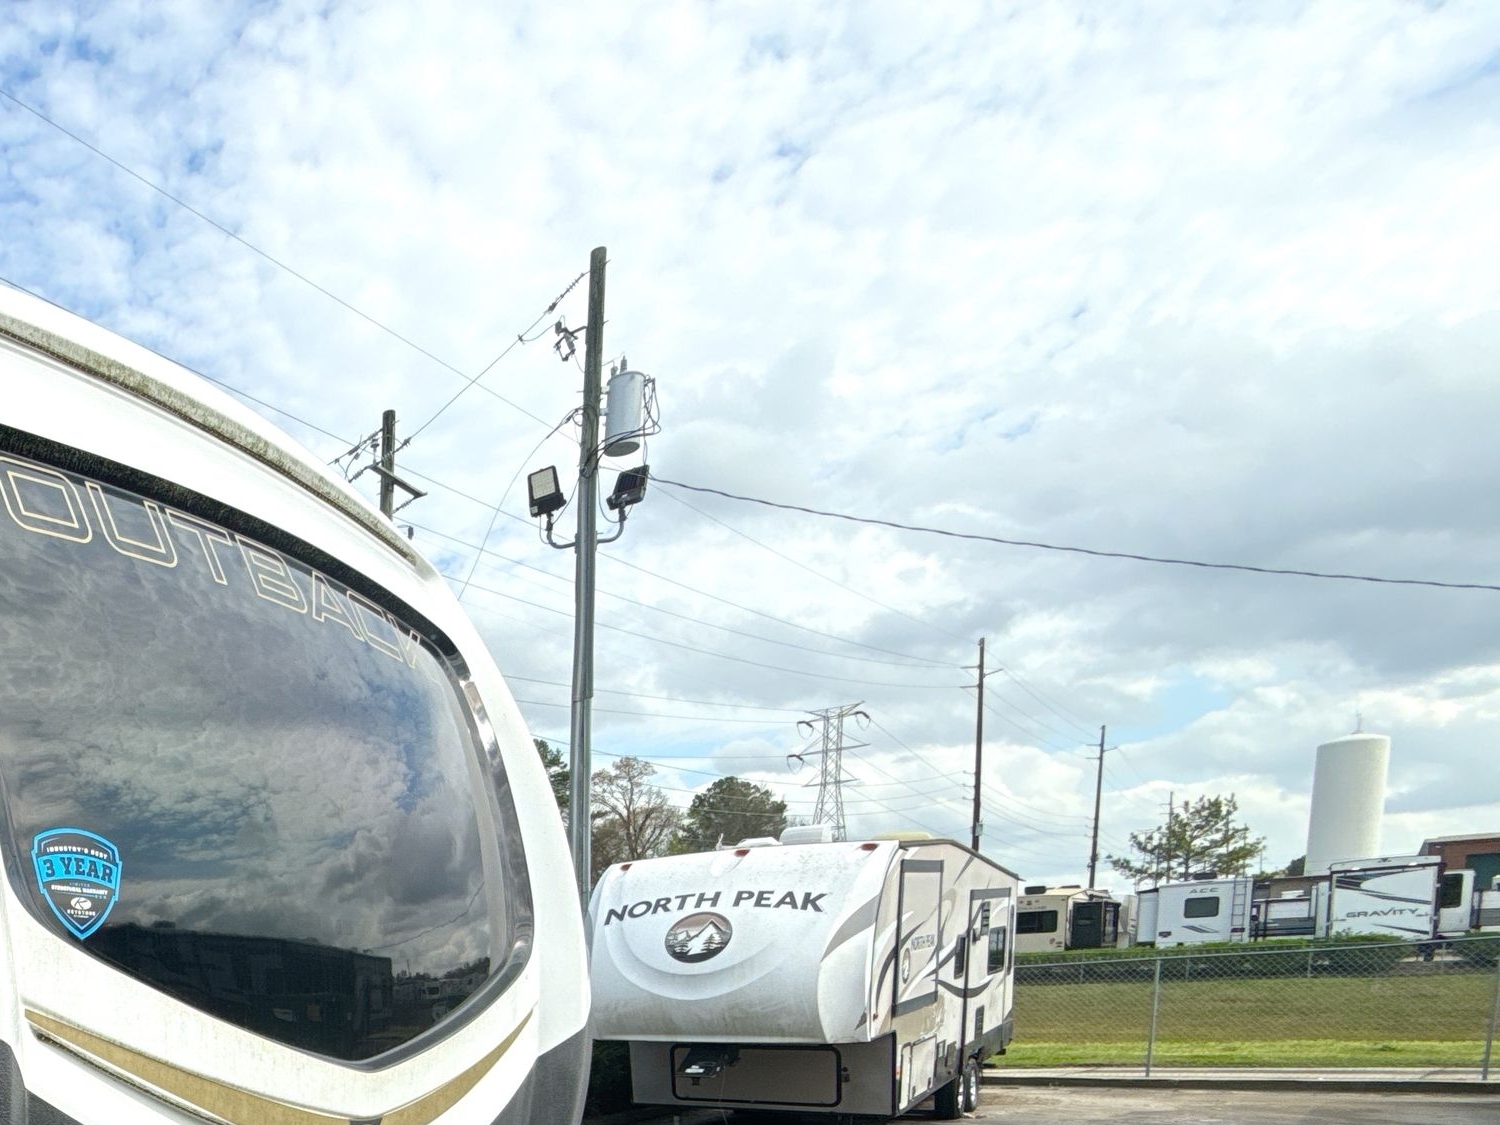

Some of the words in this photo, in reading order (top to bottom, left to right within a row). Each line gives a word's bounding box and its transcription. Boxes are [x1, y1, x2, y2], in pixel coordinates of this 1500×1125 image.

[90, 849, 108, 859] BEST
[43, 858, 56, 878] 3
[60, 857, 113, 884] YEAR
[604, 891, 722, 926] NORTH
[732, 890, 828, 913] PEAK
[1346, 907, 1420, 918] GRAVITY
